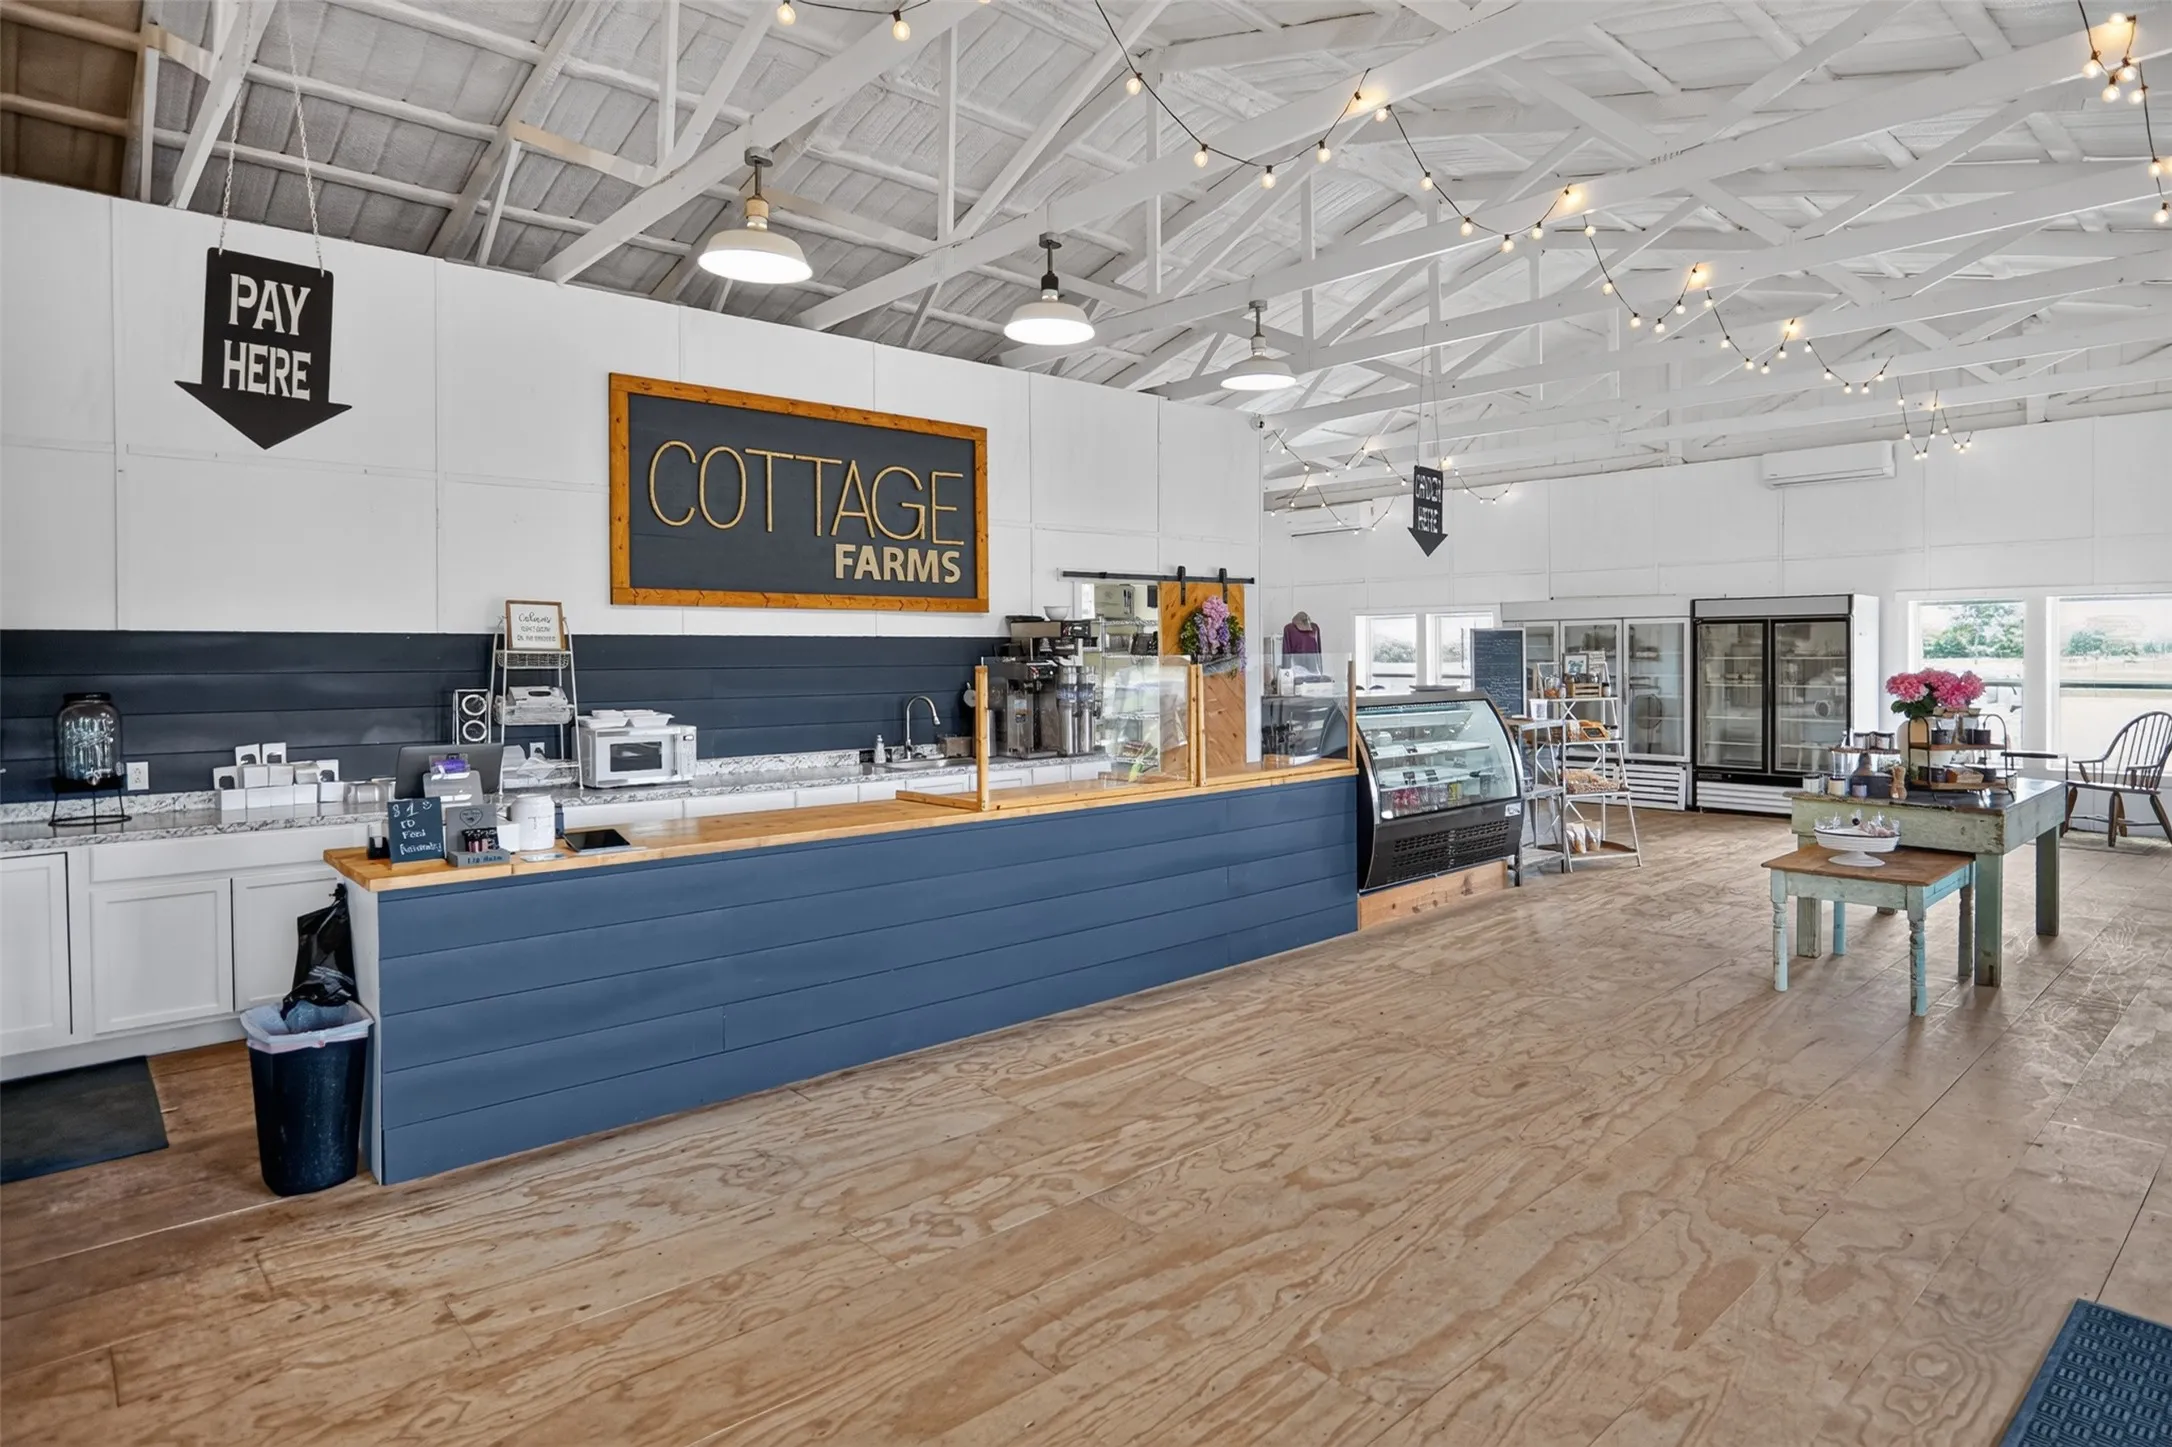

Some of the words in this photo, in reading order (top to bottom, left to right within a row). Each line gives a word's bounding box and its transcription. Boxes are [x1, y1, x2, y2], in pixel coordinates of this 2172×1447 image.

[228, 273, 311, 336] PAY
[222, 339, 311, 401] HERE
[649, 439, 964, 546] COTTAGE
[834, 543, 962, 583] FARMS
